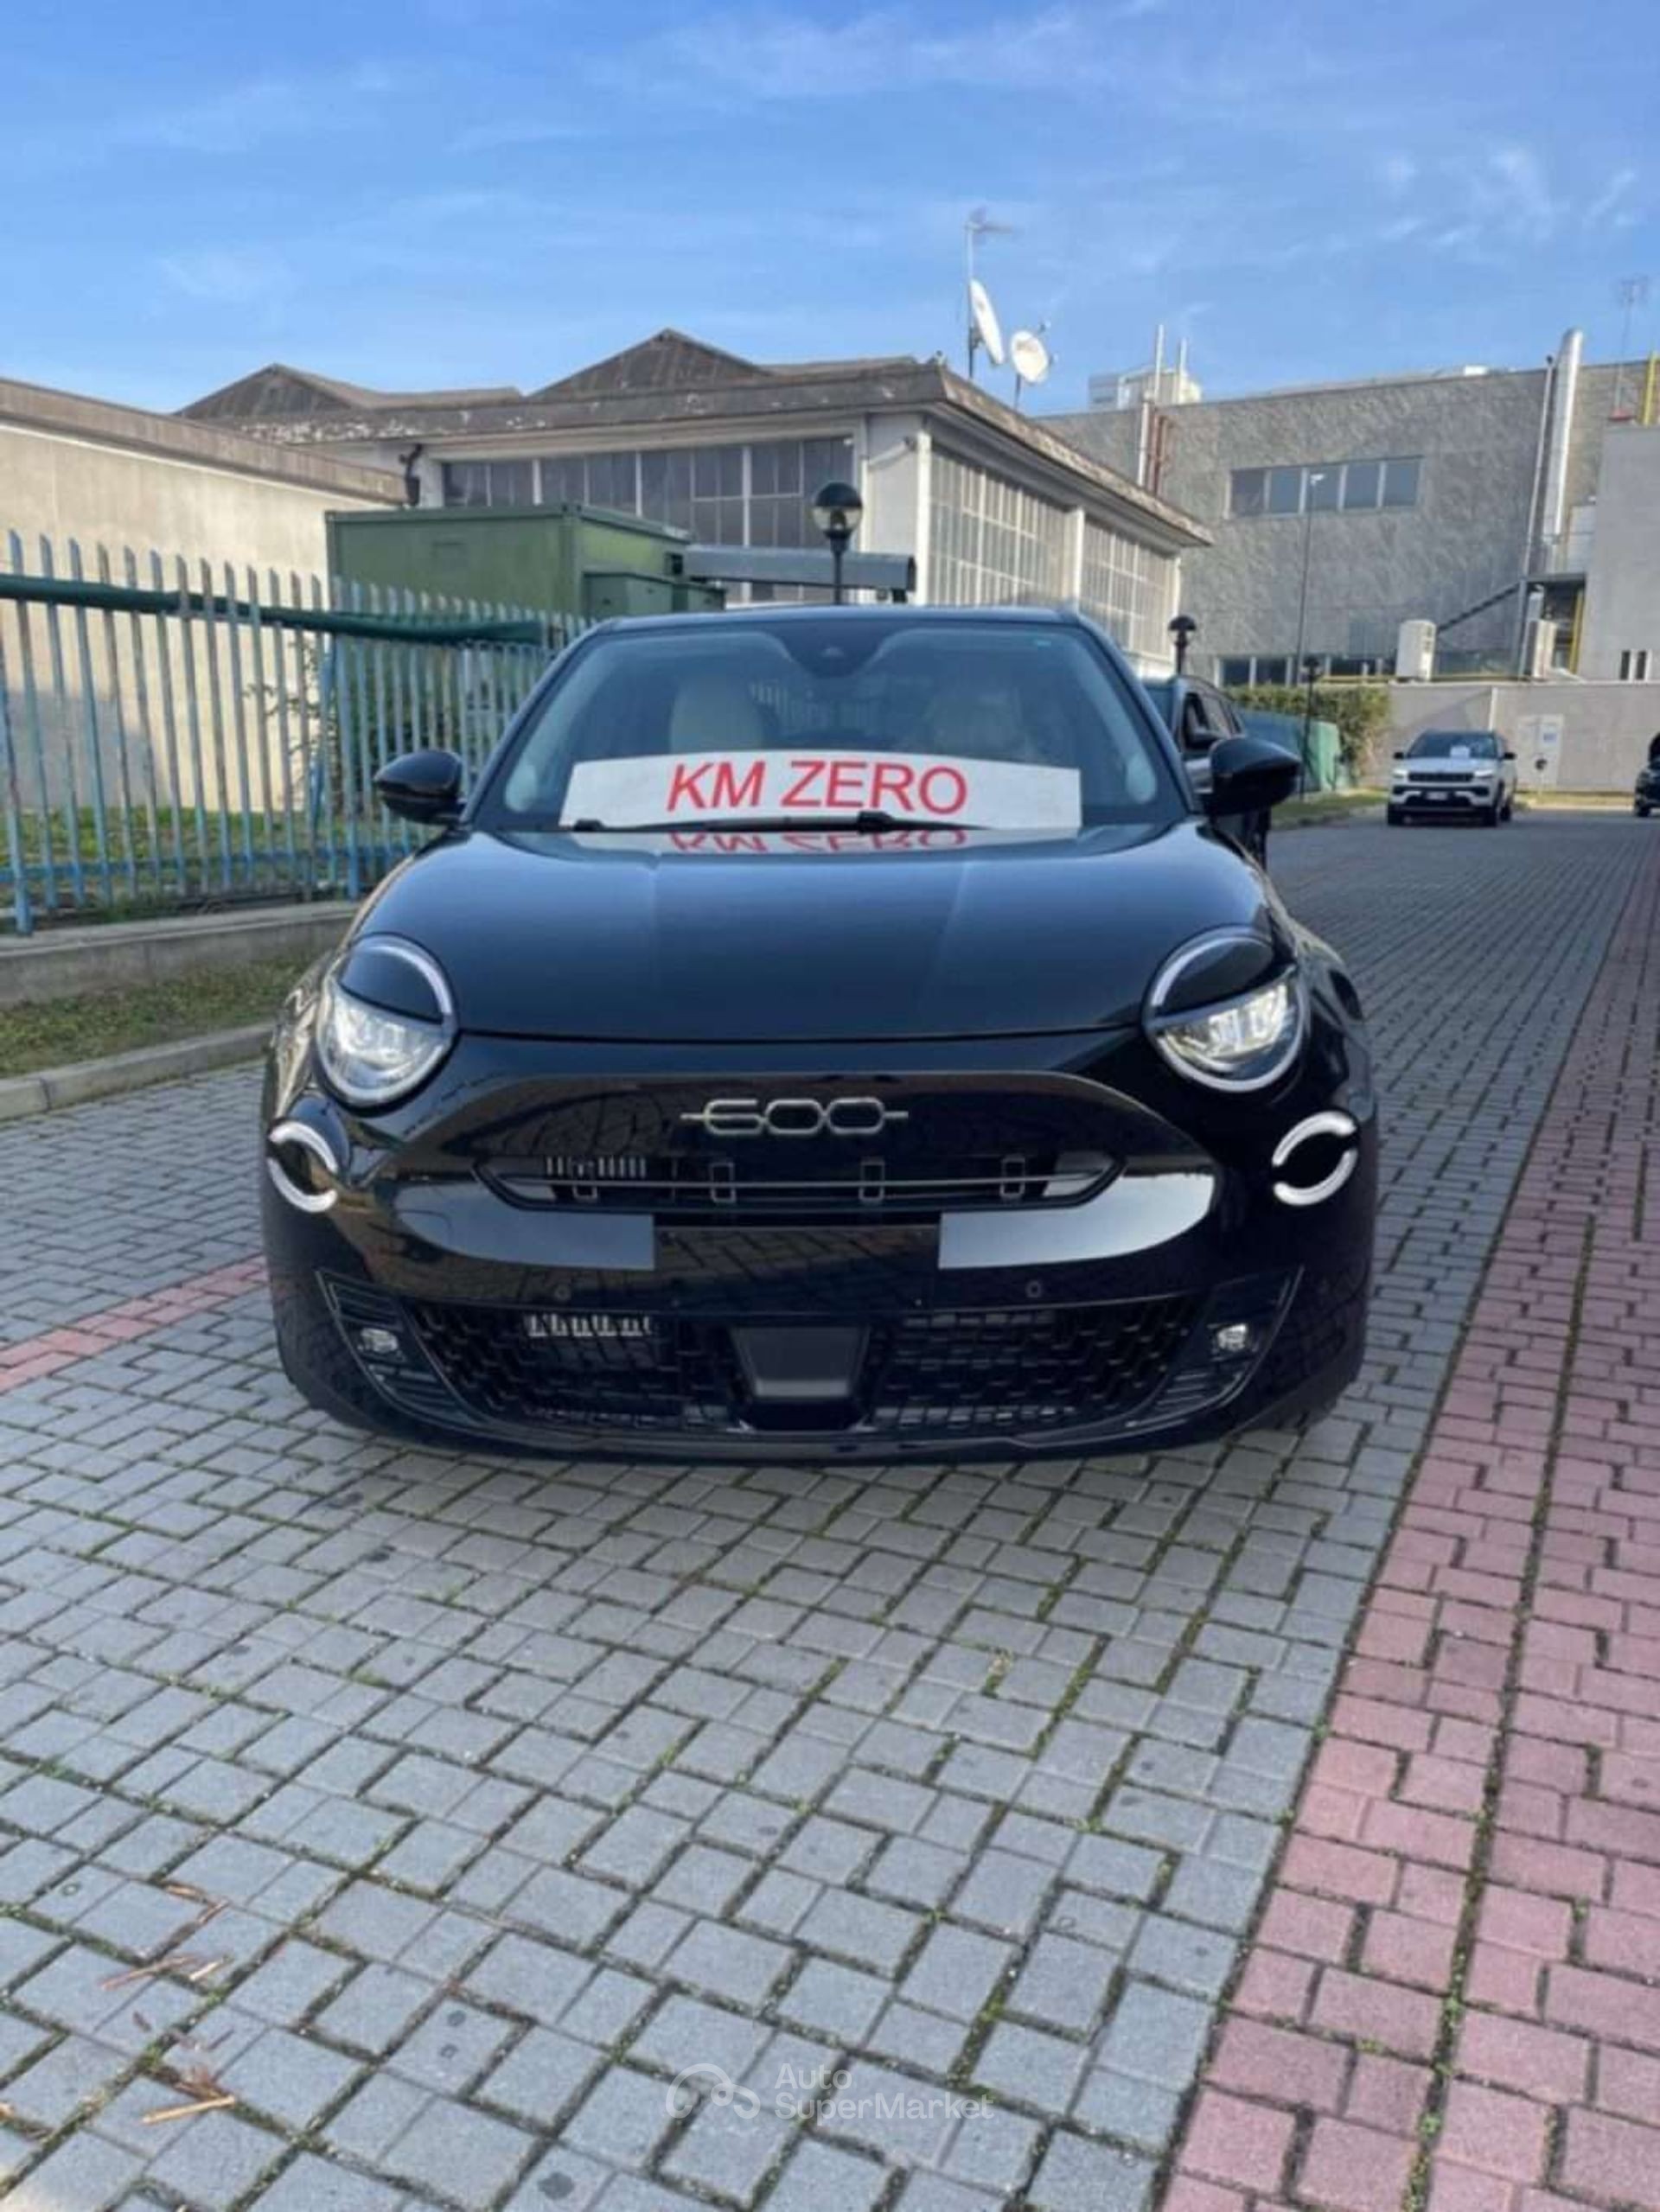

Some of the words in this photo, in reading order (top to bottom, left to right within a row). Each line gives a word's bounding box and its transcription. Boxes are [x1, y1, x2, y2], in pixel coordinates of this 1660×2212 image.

[666, 761, 767, 812] KM
[780, 760, 968, 815] ZERO
[702, 1096, 885, 1135] 600
